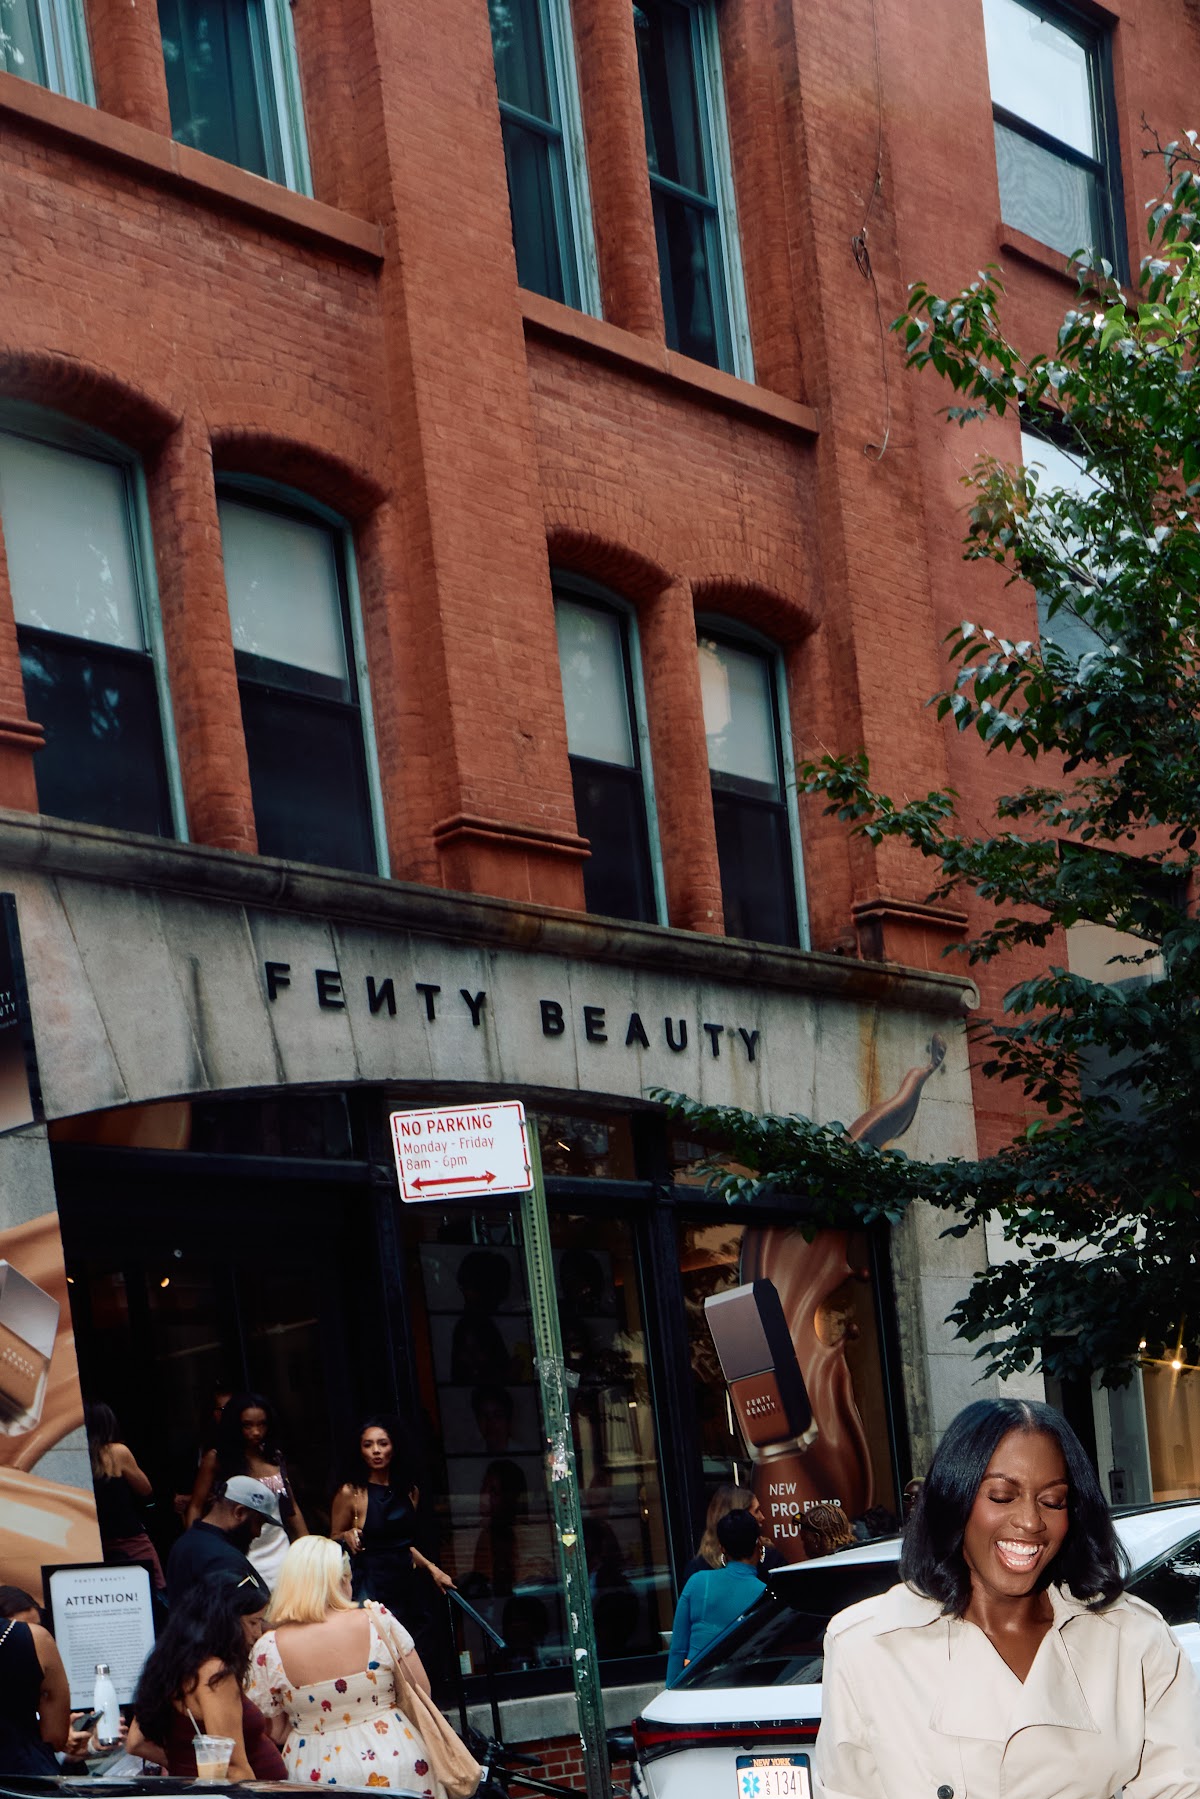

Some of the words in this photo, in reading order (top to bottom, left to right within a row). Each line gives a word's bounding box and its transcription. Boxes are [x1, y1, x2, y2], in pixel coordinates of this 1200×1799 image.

[539, 999, 761, 1062] BEAUTY
[400, 1120, 422, 1137] NO
[427, 1114, 493, 1135] PARKING
[403, 1140, 447, 1155] Monday
[459, 1136, 494, 1149] Friday
[406, 1158, 431, 1171] 8am
[442, 1155, 468, 1169] 6pm
[746, 1402, 775, 1416] BEAUTY
[769, 1482, 797, 1496] NEW
[771, 1501, 800, 1517] PRO
[65, 1592, 138, 1606] ATTENTION!
[753, 1759, 771, 1767] NEW
[771, 1757, 791, 1767] YORK
[774, 1770, 803, 1796] 1341
